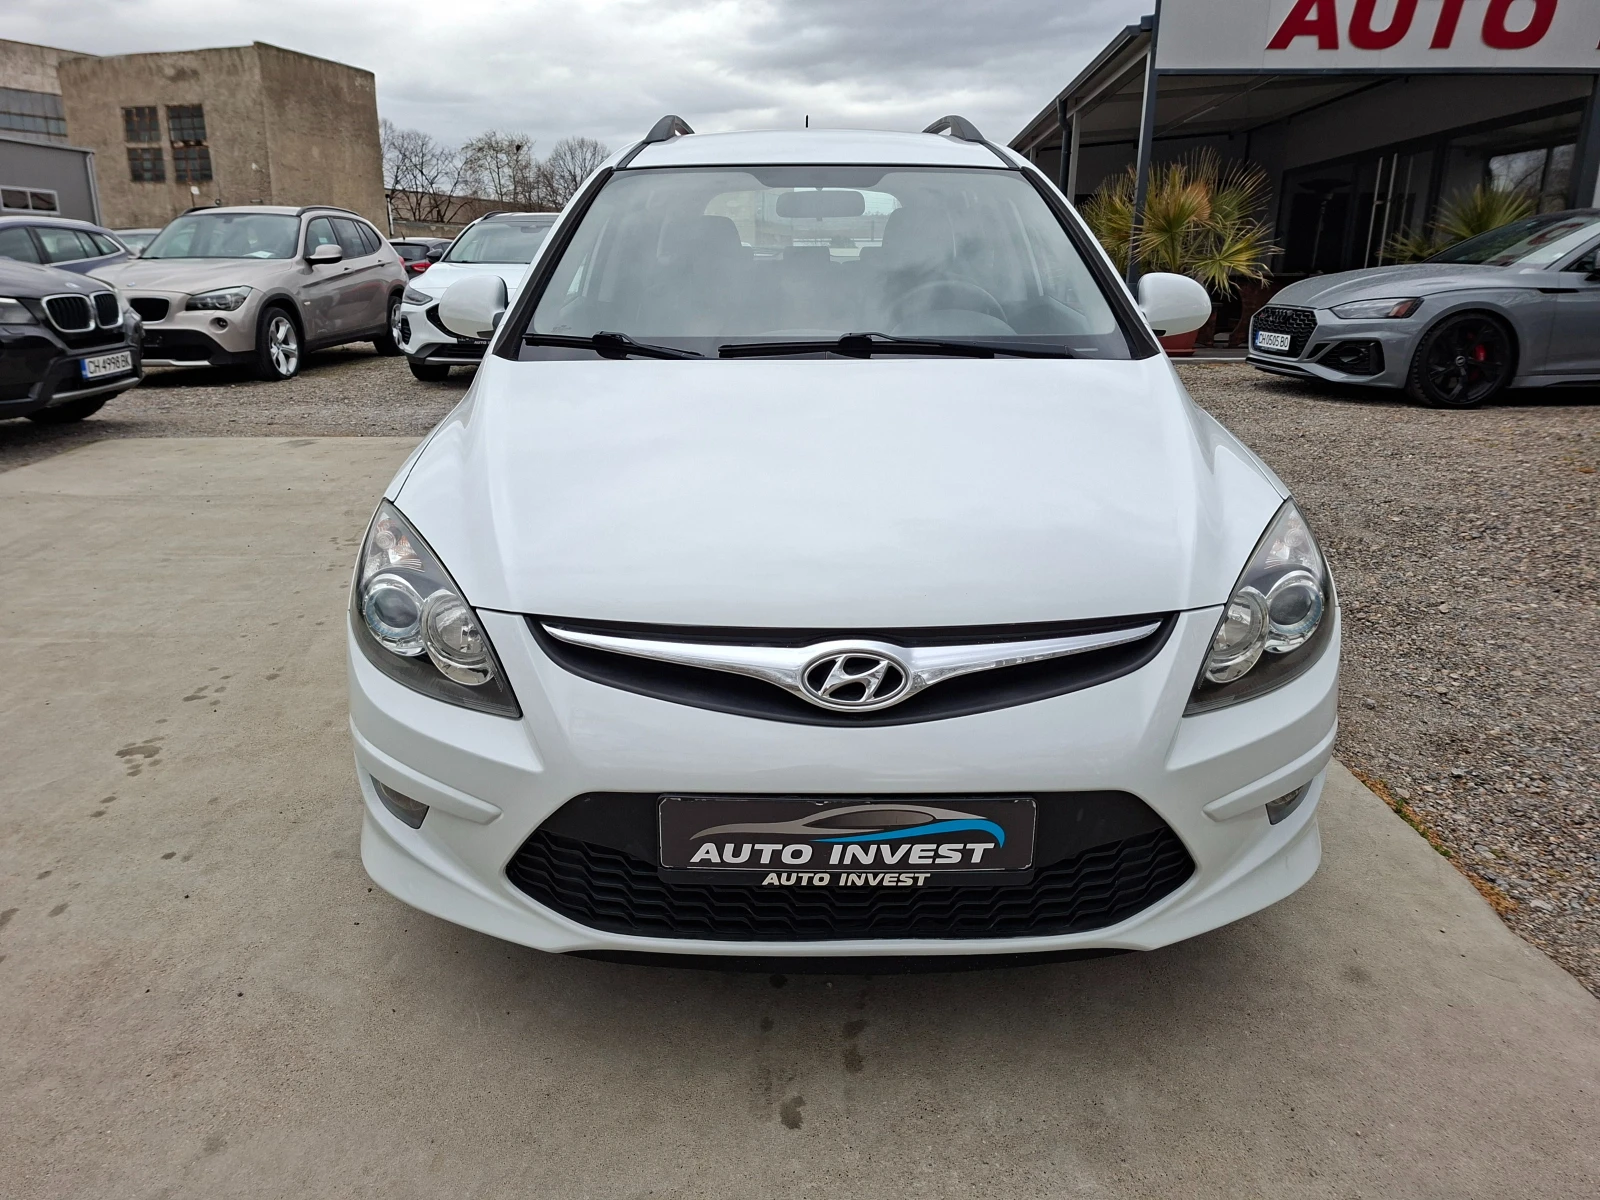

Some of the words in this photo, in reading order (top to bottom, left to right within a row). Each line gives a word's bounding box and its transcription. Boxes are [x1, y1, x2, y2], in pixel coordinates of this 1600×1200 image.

[1265, 0, 1558, 50] AUTO
[690, 842, 813, 865] AUTO
[829, 843, 995, 865] INVEST
[762, 872, 831, 886] AUTO
[839, 872, 931, 886] INVEST
